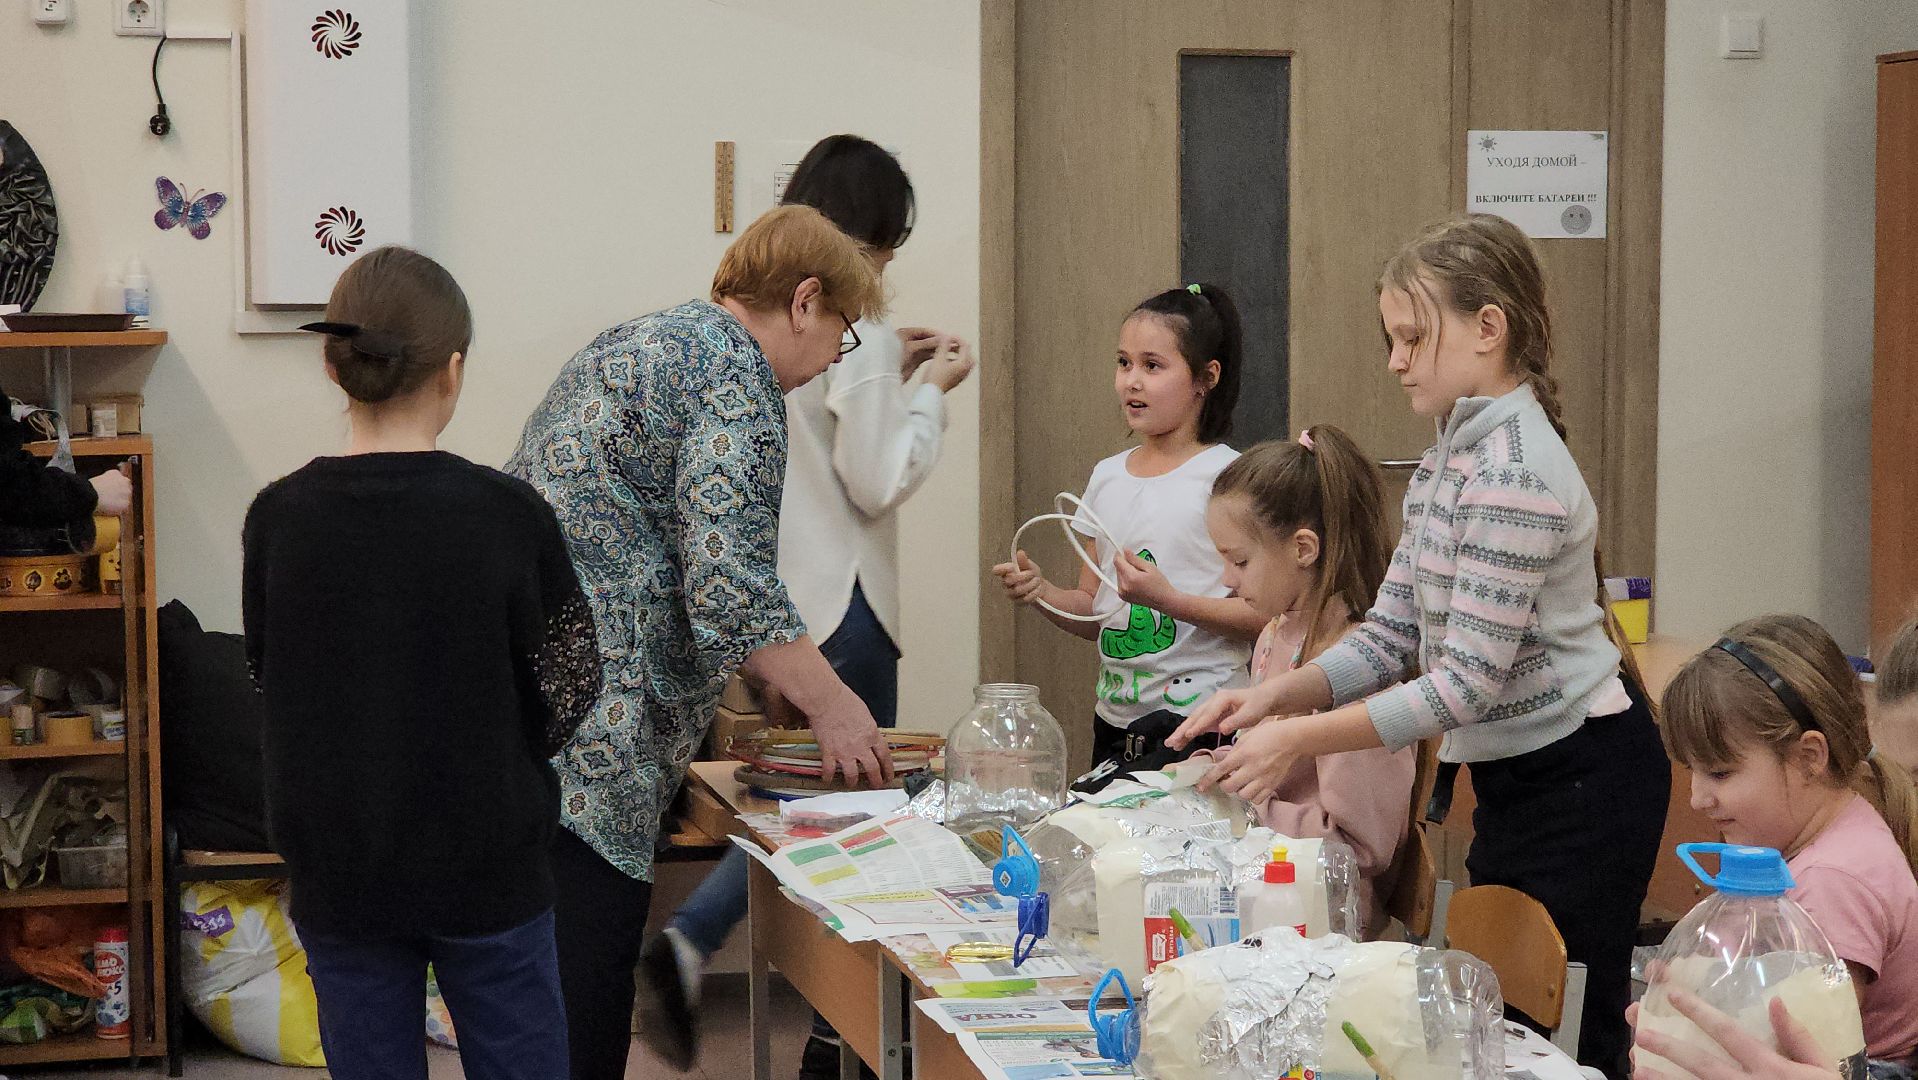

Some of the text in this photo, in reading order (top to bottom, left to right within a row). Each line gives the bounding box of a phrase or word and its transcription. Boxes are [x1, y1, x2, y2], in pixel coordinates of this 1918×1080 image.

[1487, 157, 1529, 168] УХОДЯ
[1532, 154, 1577, 168] ДОМОЙ
[1475, 194, 1535, 203] ВКЛЮЧИТЕ
[1538, 193, 1584, 203] БАТАРЕИ
